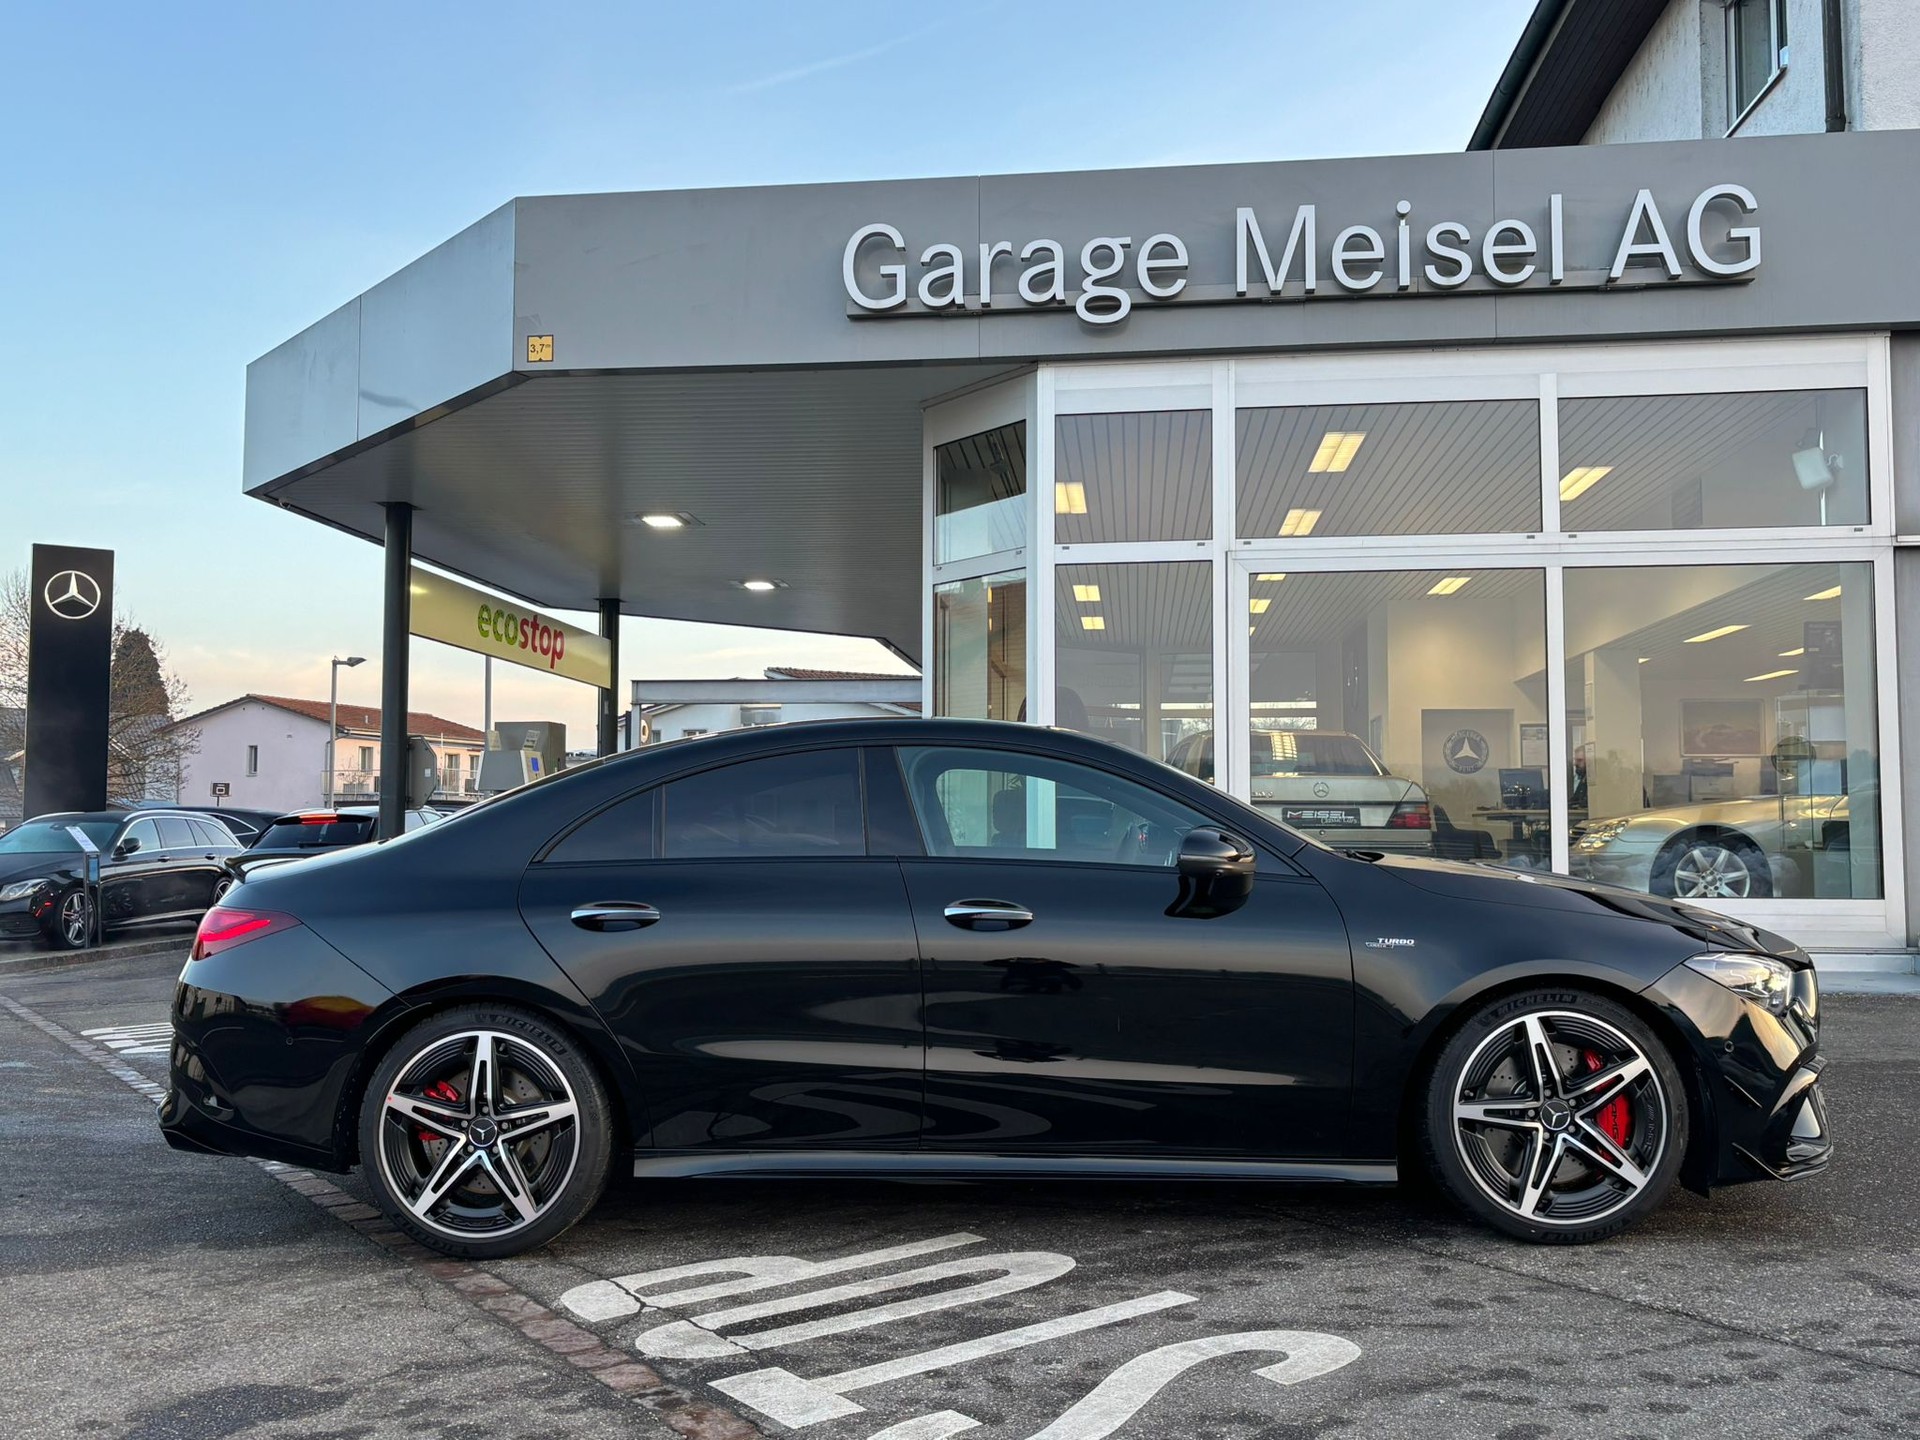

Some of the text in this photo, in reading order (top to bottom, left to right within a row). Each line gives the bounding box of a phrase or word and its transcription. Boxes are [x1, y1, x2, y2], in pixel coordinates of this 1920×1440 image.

[843, 183, 1762, 324] Garage Meisel AG
[477, 603, 565, 670] ecostop
[1287, 810, 1354, 819] MEISEL
[1377, 937, 1415, 946] TURBO
[1499, 994, 1574, 1016] MICHELIN
[495, 1015, 565, 1053] MICHELIN
